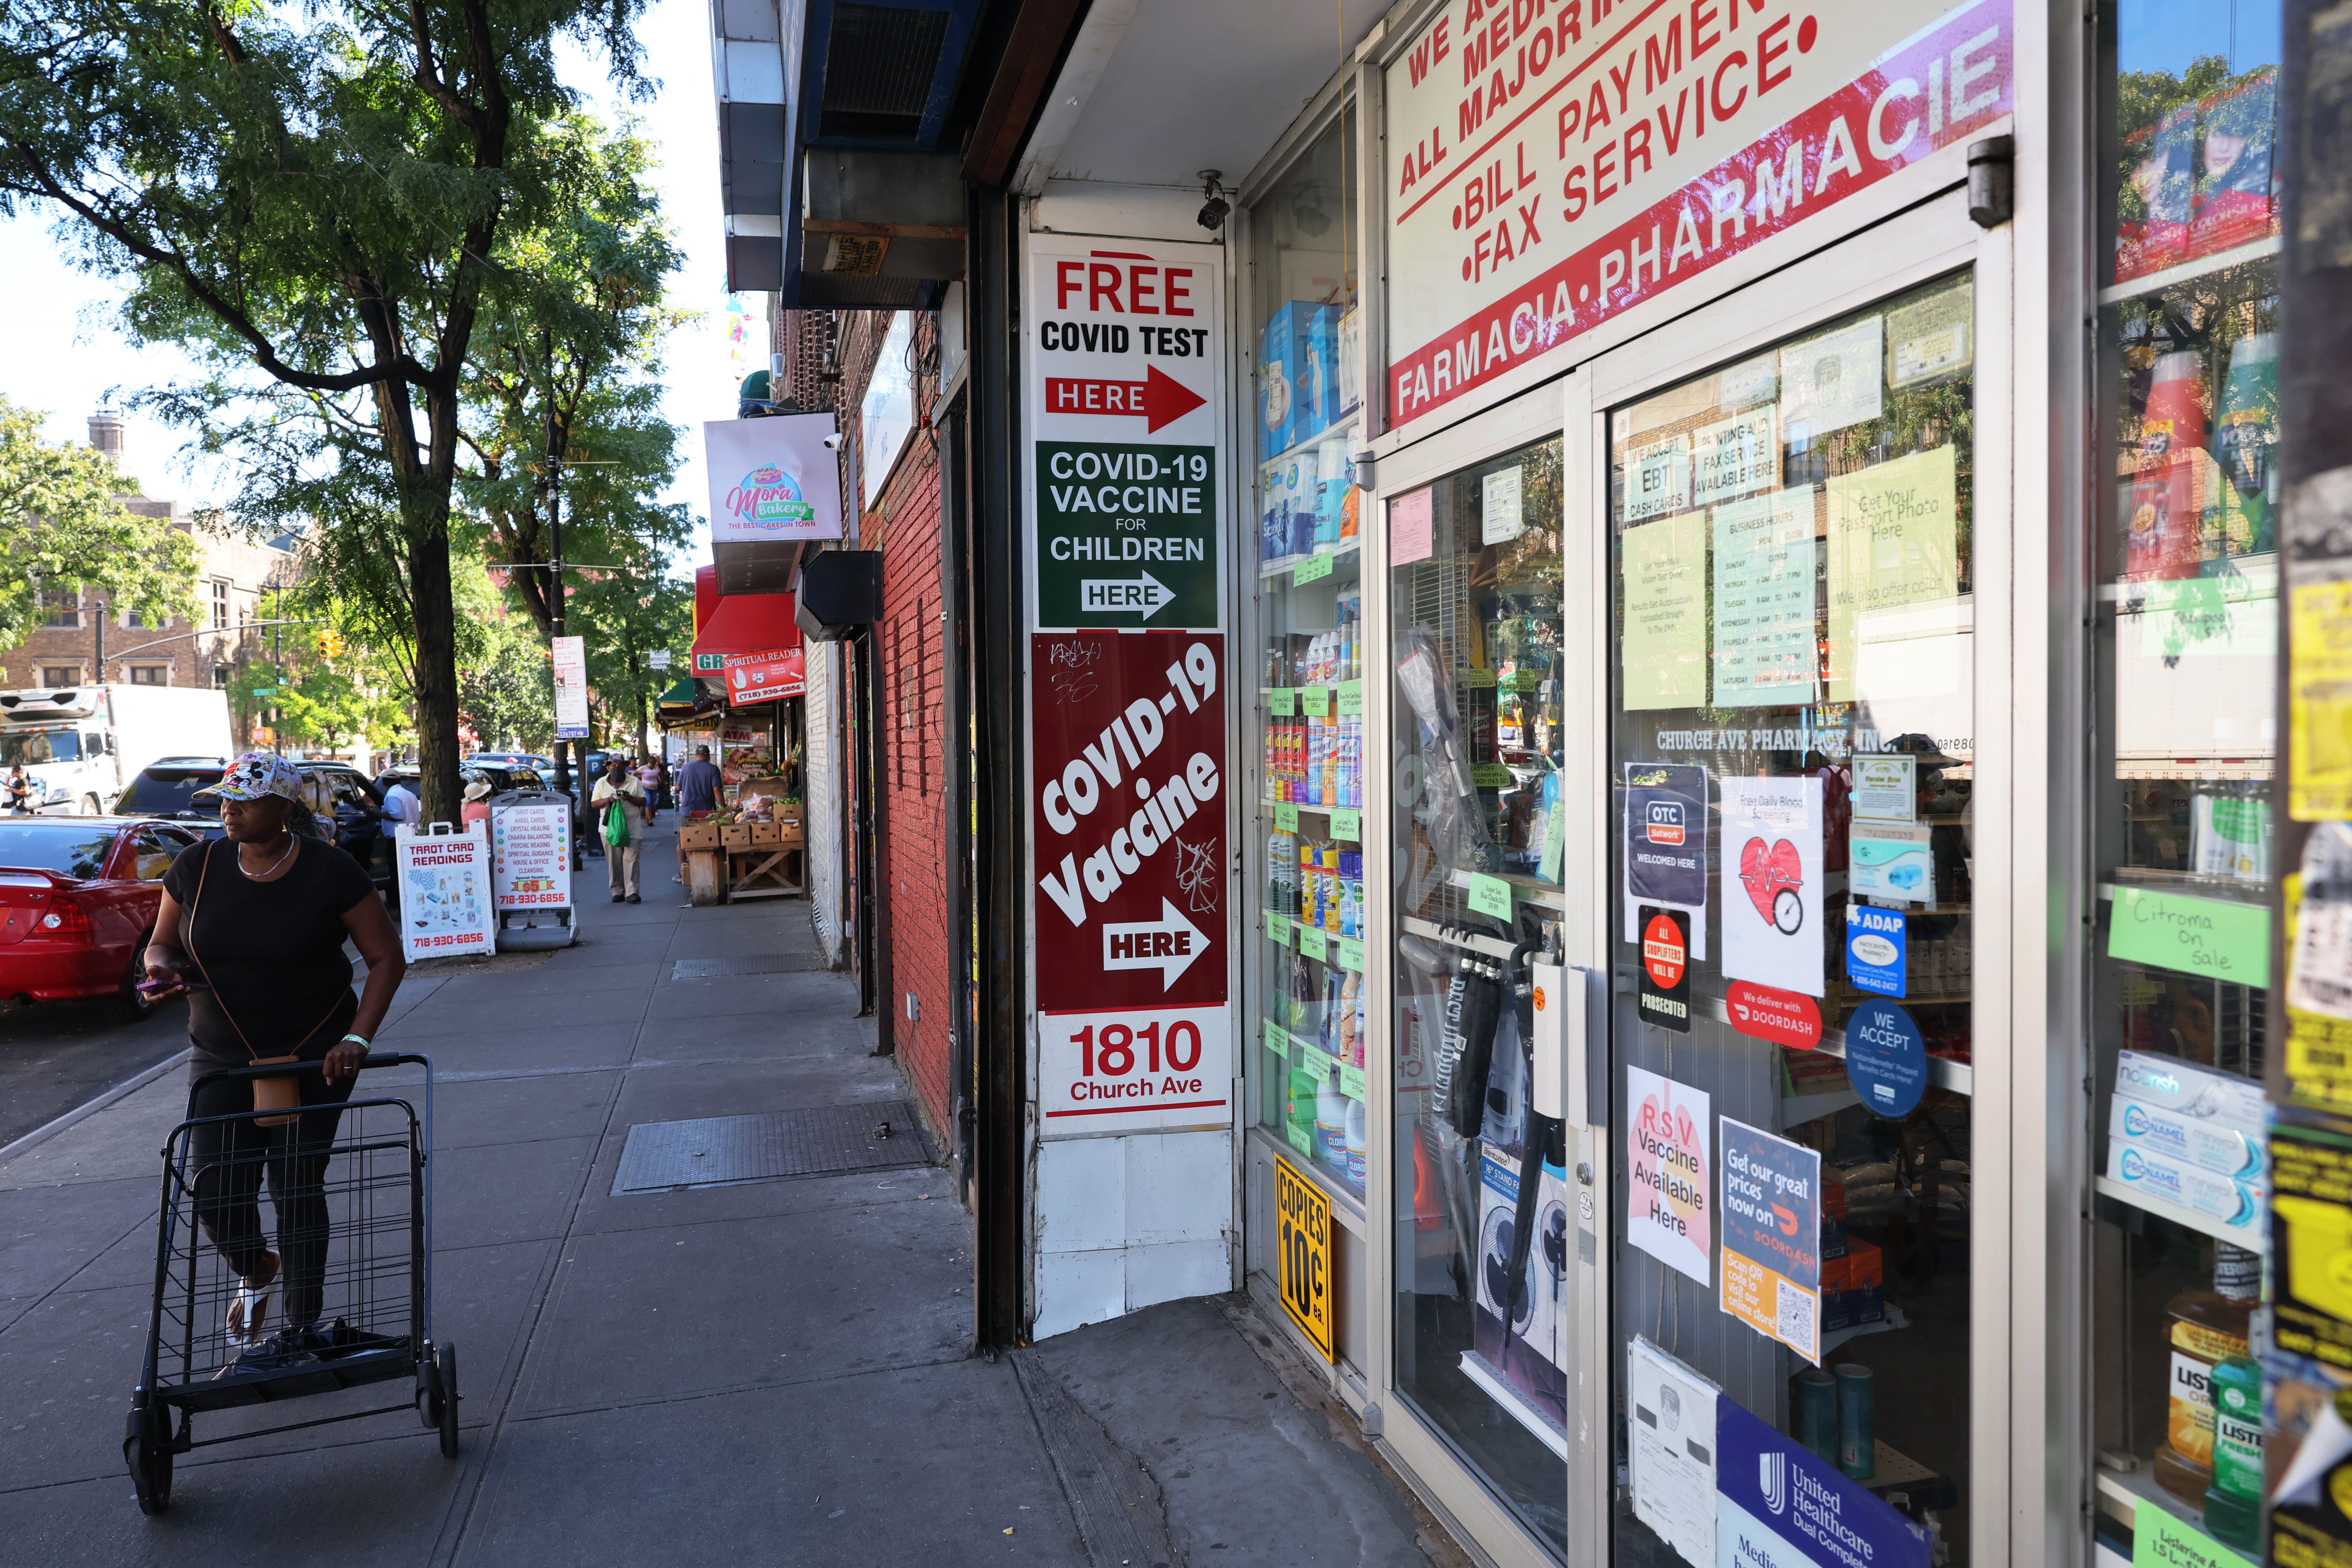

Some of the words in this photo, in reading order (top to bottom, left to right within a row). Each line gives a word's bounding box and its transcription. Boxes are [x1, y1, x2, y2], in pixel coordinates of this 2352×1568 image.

[1408, 14, 1449, 89] WE
[1459, 0, 1582, 143] MAJOR
[1466, 142, 1536, 230] BILL
[1559, 0, 1764, 161] PAYMEN
[1399, 125, 1446, 197] ALL
[1475, 194, 1541, 284] FAX
[1563, 13, 1791, 222] SERVICE
[833, 237, 853, 272] EMPIRE
[850, 241, 862, 256] CORP.
[859, 240, 880, 273] 718-344-7950
[846, 257, 855, 271] GATES
[1057, 261, 1194, 316] FREE
[1041, 321, 1129, 353] COVID
[1140, 326, 1208, 357] TEST
[1058, 383, 1145, 410] HERE
[1702, 425, 1744, 449] PRINTING
[1748, 418, 1768, 436] AND
[1646, 438, 1678, 460] ACCEPT
[1704, 454, 1722, 470] FAX
[1725, 441, 1765, 464] SERVICE
[1051, 452, 1207, 481] COVID-19
[1643, 465, 1668, 492] EBT
[1695, 468, 1745, 495] AVAILABLE
[1748, 460, 1773, 482] HERE
[726, 486, 795, 520] Mora
[759, 502, 808, 516] Bakery
[1050, 485, 1202, 514] VACCINE
[1630, 502, 1651, 517] CASH
[1654, 494, 1682, 512] CARDS
[1859, 494, 1881, 513] Get
[1885, 488, 1916, 506] Your
[1116, 519, 1147, 530] FOR
[1730, 518, 1764, 534] BUSINESS
[1766, 513, 1793, 528] HOURS
[1838, 509, 1893, 532] Passport
[1898, 499, 1939, 520] Photo
[1871, 524, 1903, 542] Here
[1051, 537, 1204, 561] CHILDREN
[1089, 586, 1159, 605] HERE
[724, 654, 767, 668] SPIRITUAL
[768, 648, 802, 661] READER
[752, 672, 764, 684] $5
[739, 691, 760, 700] (718)
[762, 684, 801, 696] 930-6856
[723, 730, 750, 740] ATM
[1043, 642, 1216, 835] COVID-19
[1657, 731, 1713, 750] CHURCH
[1717, 730, 1747, 750] AVE
[1858, 730, 1896, 752] INC.
[592, 762, 598, 771] P
[1741, 795, 1757, 806] Free
[1759, 796, 1778, 807] Daily
[1780, 797, 1802, 808] Blood
[1652, 807, 1677, 822] OTC
[1752, 808, 1791, 823] Screening
[1039, 752, 1219, 927] Vaccine
[1651, 828, 1679, 839] Network
[410, 844, 443, 855] TAROT
[447, 843, 474, 853] CARD
[413, 854, 472, 866] READINGS
[1637, 853, 1675, 866] WELCOMED
[1677, 858, 1695, 869] HERE
[500, 893, 564, 904] 718-930-6856
[523, 880, 539, 893] $5
[1863, 913, 1903, 933] ADAP
[2134, 897, 2213, 930] Citroma
[414, 933, 483, 948] 718-930-6856
[1111, 931, 1191, 959] HERE
[1659, 927, 1668, 940] ALL
[1647, 944, 1681, 961] SHOPLIFTERS
[1653, 964, 1666, 976] WILL
[1668, 966, 1675, 978] BE
[1642, 993, 1686, 1018] PROSECUTED
[1743, 991, 1756, 1002] We
[1757, 993, 1782, 1008] deliver
[1784, 999, 1801, 1013] with
[1752, 1010, 1813, 1035] DOORDASH
[1874, 1011, 1895, 1030] WE
[1070, 1020, 1201, 1076] 1810
[1859, 1026, 1910, 1051] ACCEPT
[1071, 1078, 1153, 1100] Church
[1161, 1076, 1202, 1095] Ave
[2120, 1065, 2180, 1096] nourish
[2129, 1116, 2185, 1142] PRONAMEL
[1484, 1147, 1508, 1166] Brentwood
[1638, 1128, 1699, 1174] Vaccine
[1495, 1169, 1512, 1186] STAND
[1635, 1160, 1703, 1210] Available
[1728, 1148, 1749, 1176] Get
[1750, 1161, 1773, 1183] our
[1775, 1170, 1808, 1200] great
[1728, 1172, 1762, 1201] prices
[2125, 1160, 2181, 1189] PRONAMEL
[1279, 1171, 1324, 1247] COPIES
[1650, 1200, 1687, 1237] Here
[1728, 1194, 1754, 1217] now
[1756, 1207, 1774, 1228] on
[1754, 1229, 1816, 1269] DOORDASH
[1728, 1253, 1748, 1275] Scan
[1749, 1264, 1763, 1283] QR
[1728, 1270, 1748, 1287] code
[1748, 1276, 1757, 1292] to
[1745, 1292, 1760, 1306] our
[1313, 1303, 1324, 1326] ea.
[1728, 1296, 1753, 1316] online
[1753, 1308, 1776, 1329] store!
[1792, 1463, 1841, 1516] United
[1793, 1486, 1874, 1561] Healthcare
[1793, 1511, 1817, 1539] Dual
